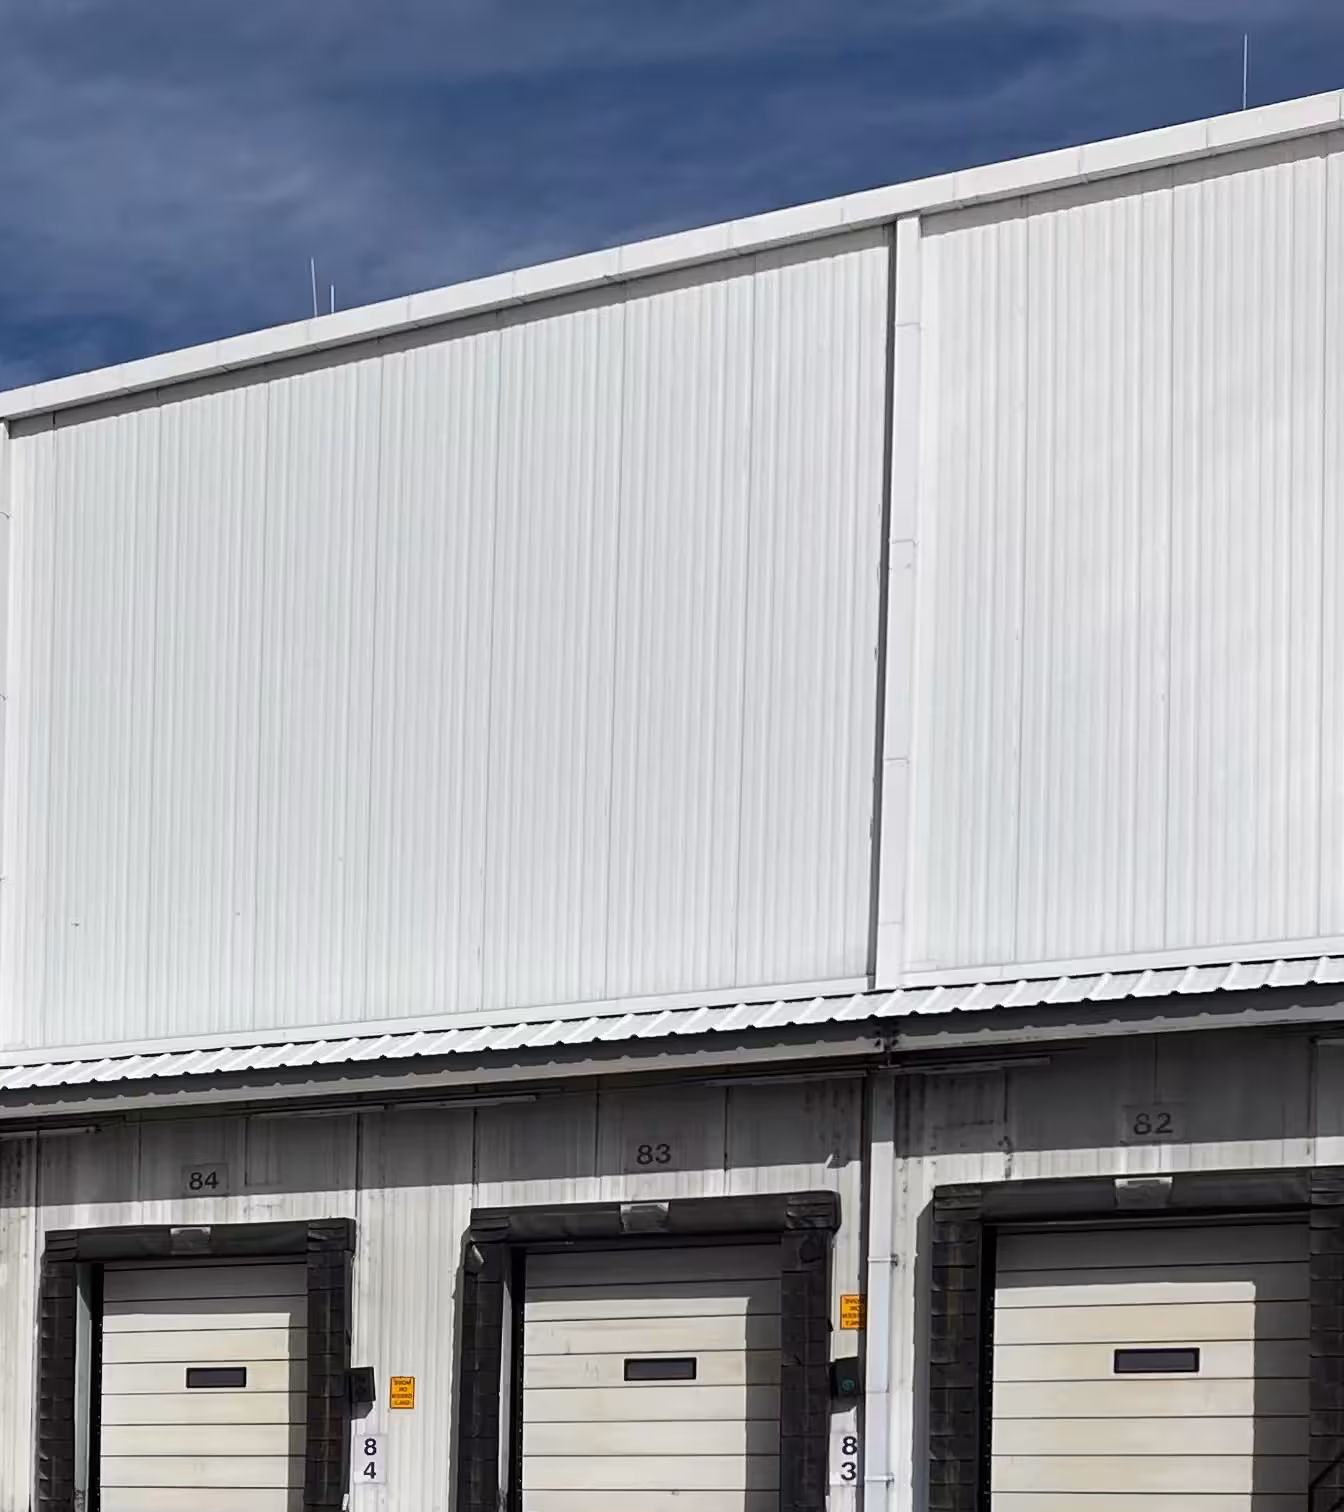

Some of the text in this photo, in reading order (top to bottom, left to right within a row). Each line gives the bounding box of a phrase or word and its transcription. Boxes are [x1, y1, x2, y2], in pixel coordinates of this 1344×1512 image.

[1133, 1112, 1174, 1135] 82
[637, 1143, 672, 1166] 83
[189, 1170, 220, 1191] 84
[363, 1437, 377, 1480] 84
[840, 1435, 858, 1481] 83
